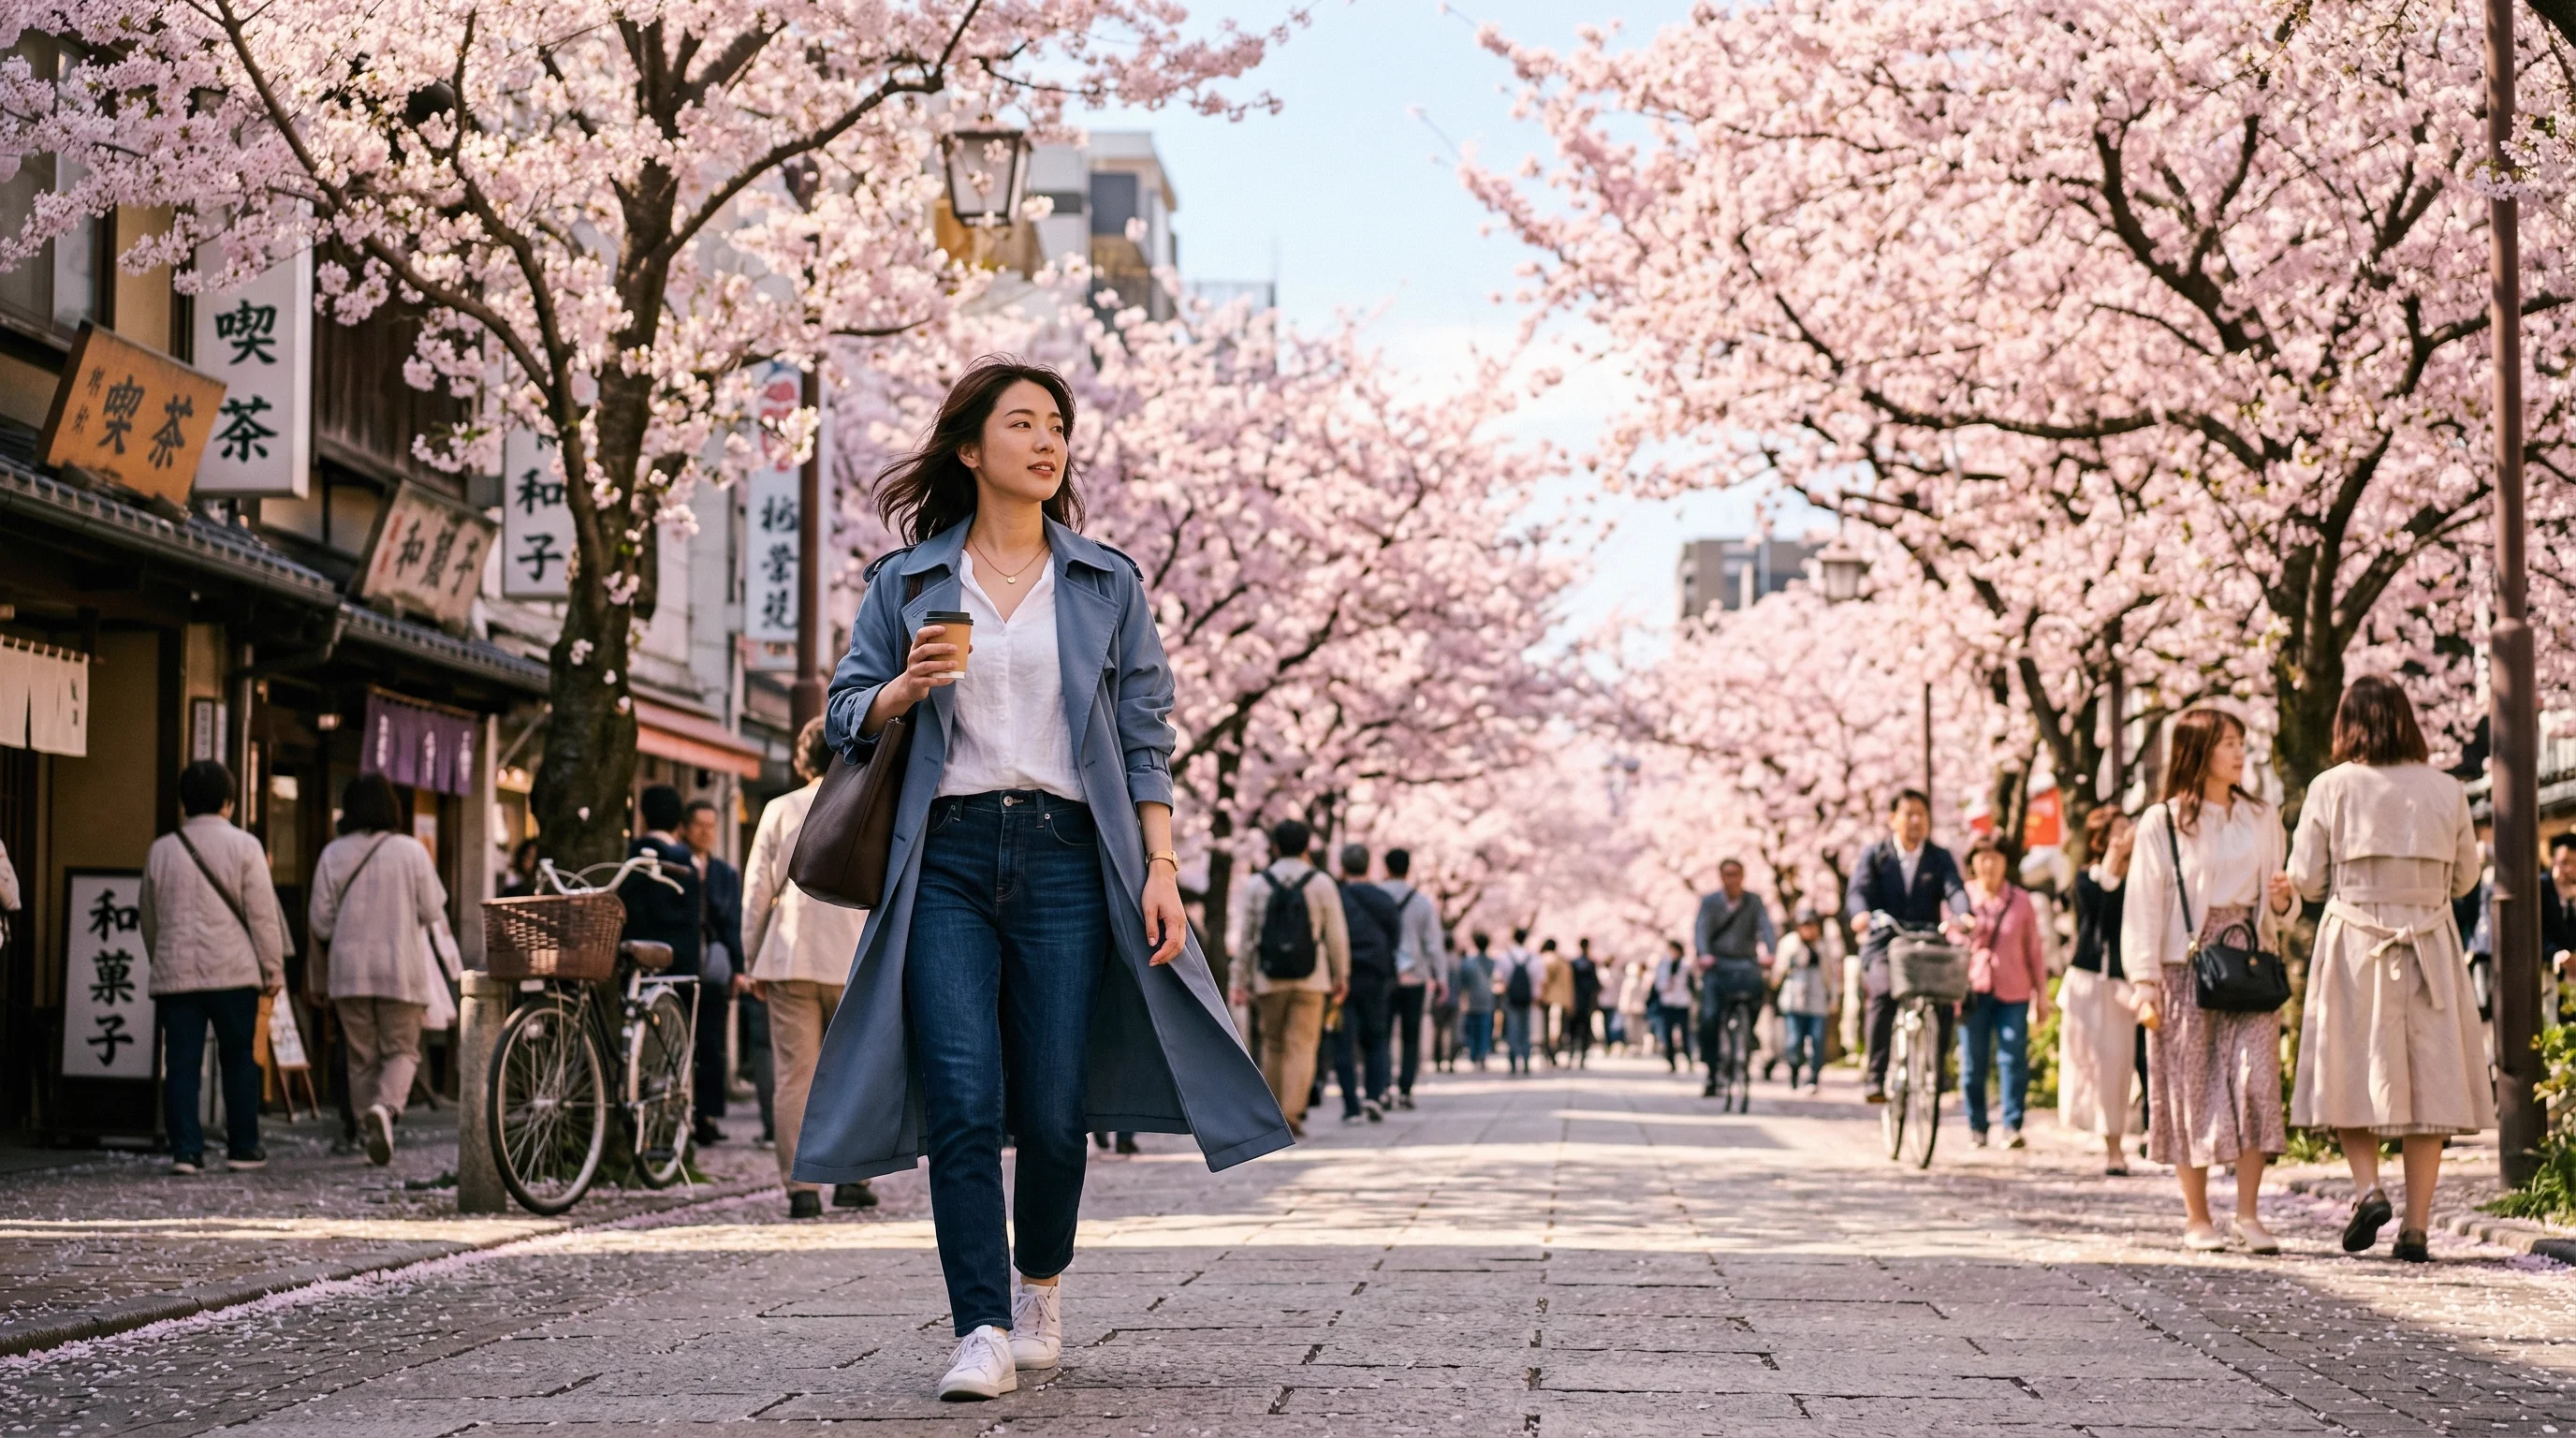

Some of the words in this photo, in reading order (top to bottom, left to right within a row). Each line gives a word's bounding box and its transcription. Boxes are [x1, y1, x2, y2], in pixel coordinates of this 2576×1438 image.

[97, 374, 194, 470] 喫茶
[214, 299, 278, 464] 喫茶
[516, 420, 564, 583] 和子
[87, 888, 139, 1067] 和菓子
